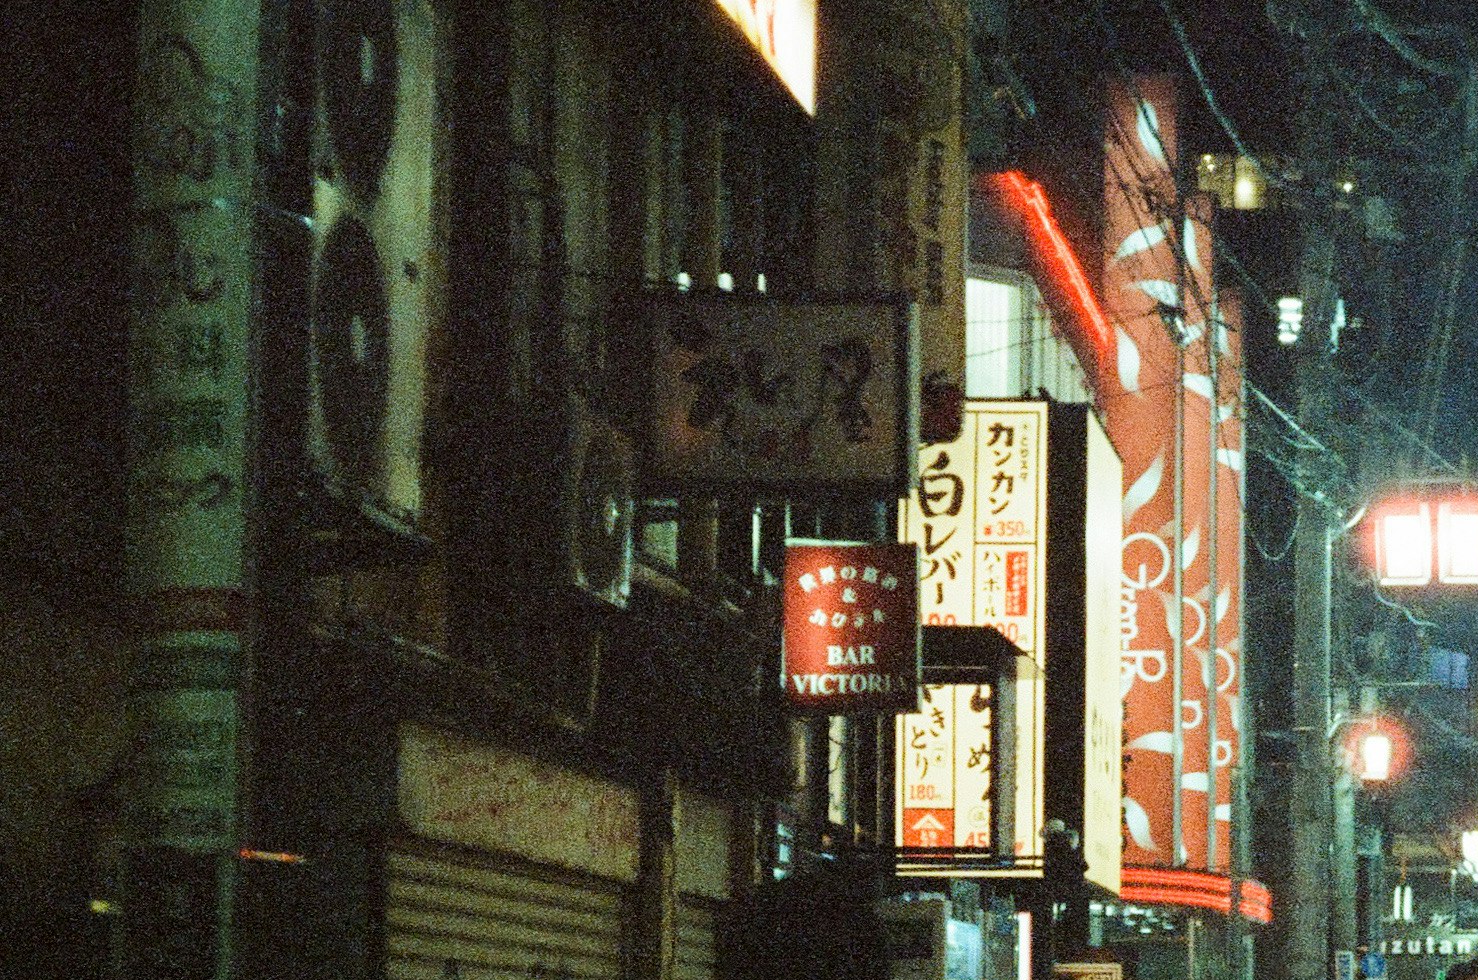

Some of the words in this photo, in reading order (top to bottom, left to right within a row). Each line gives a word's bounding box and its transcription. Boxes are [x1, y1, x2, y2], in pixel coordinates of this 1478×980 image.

[986, 422, 1015, 516] カンカン
[920, 450, 964, 605] 白レバー
[826, 645, 875, 665] BAR
[792, 673, 908, 696] VICTORIA
